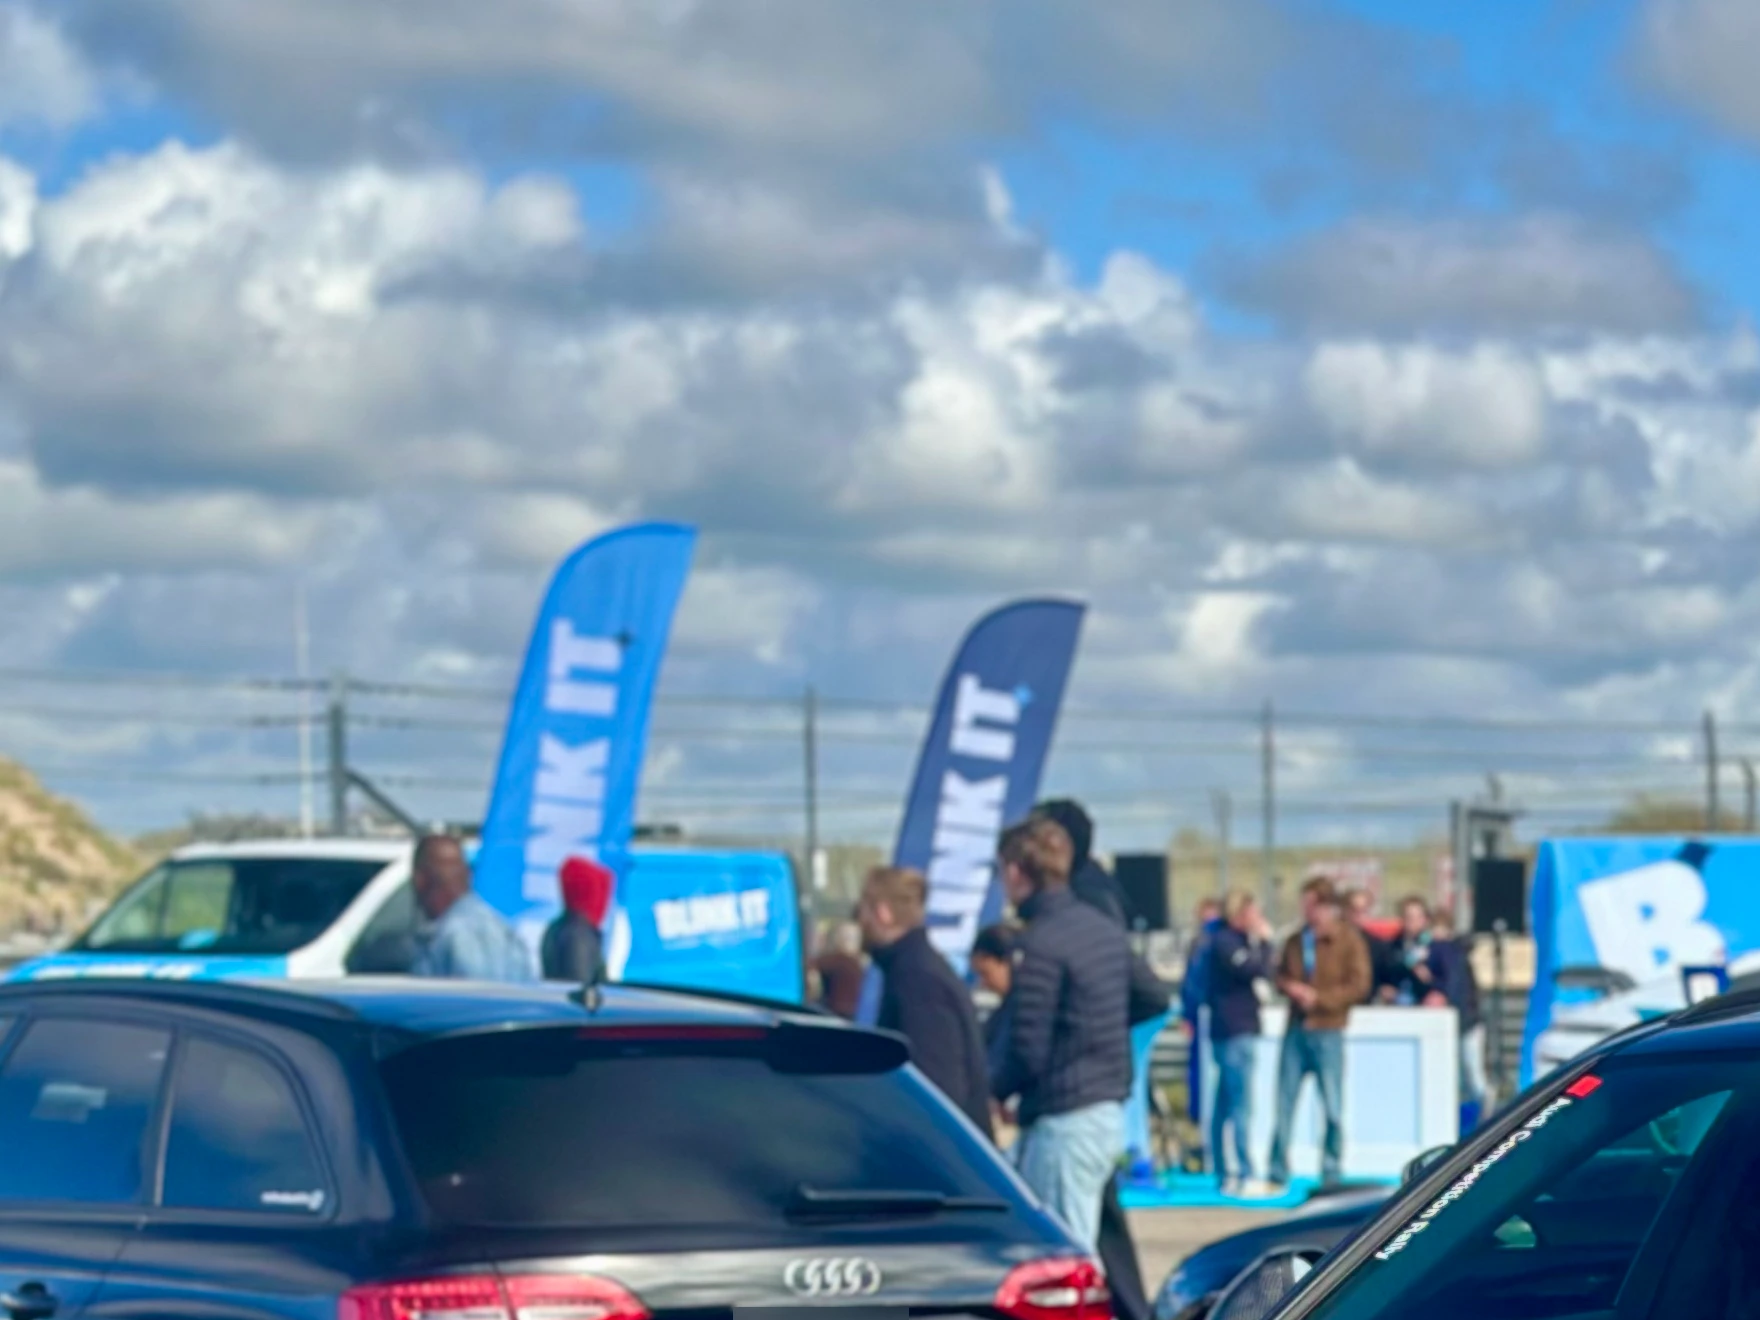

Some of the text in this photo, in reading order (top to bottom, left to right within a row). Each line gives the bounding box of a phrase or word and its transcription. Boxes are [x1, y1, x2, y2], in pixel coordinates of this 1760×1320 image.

[544, 617, 623, 717] IT
[950, 673, 1020, 762] IT
[1374, 1096, 1573, 1261] Audi Competition Rally
